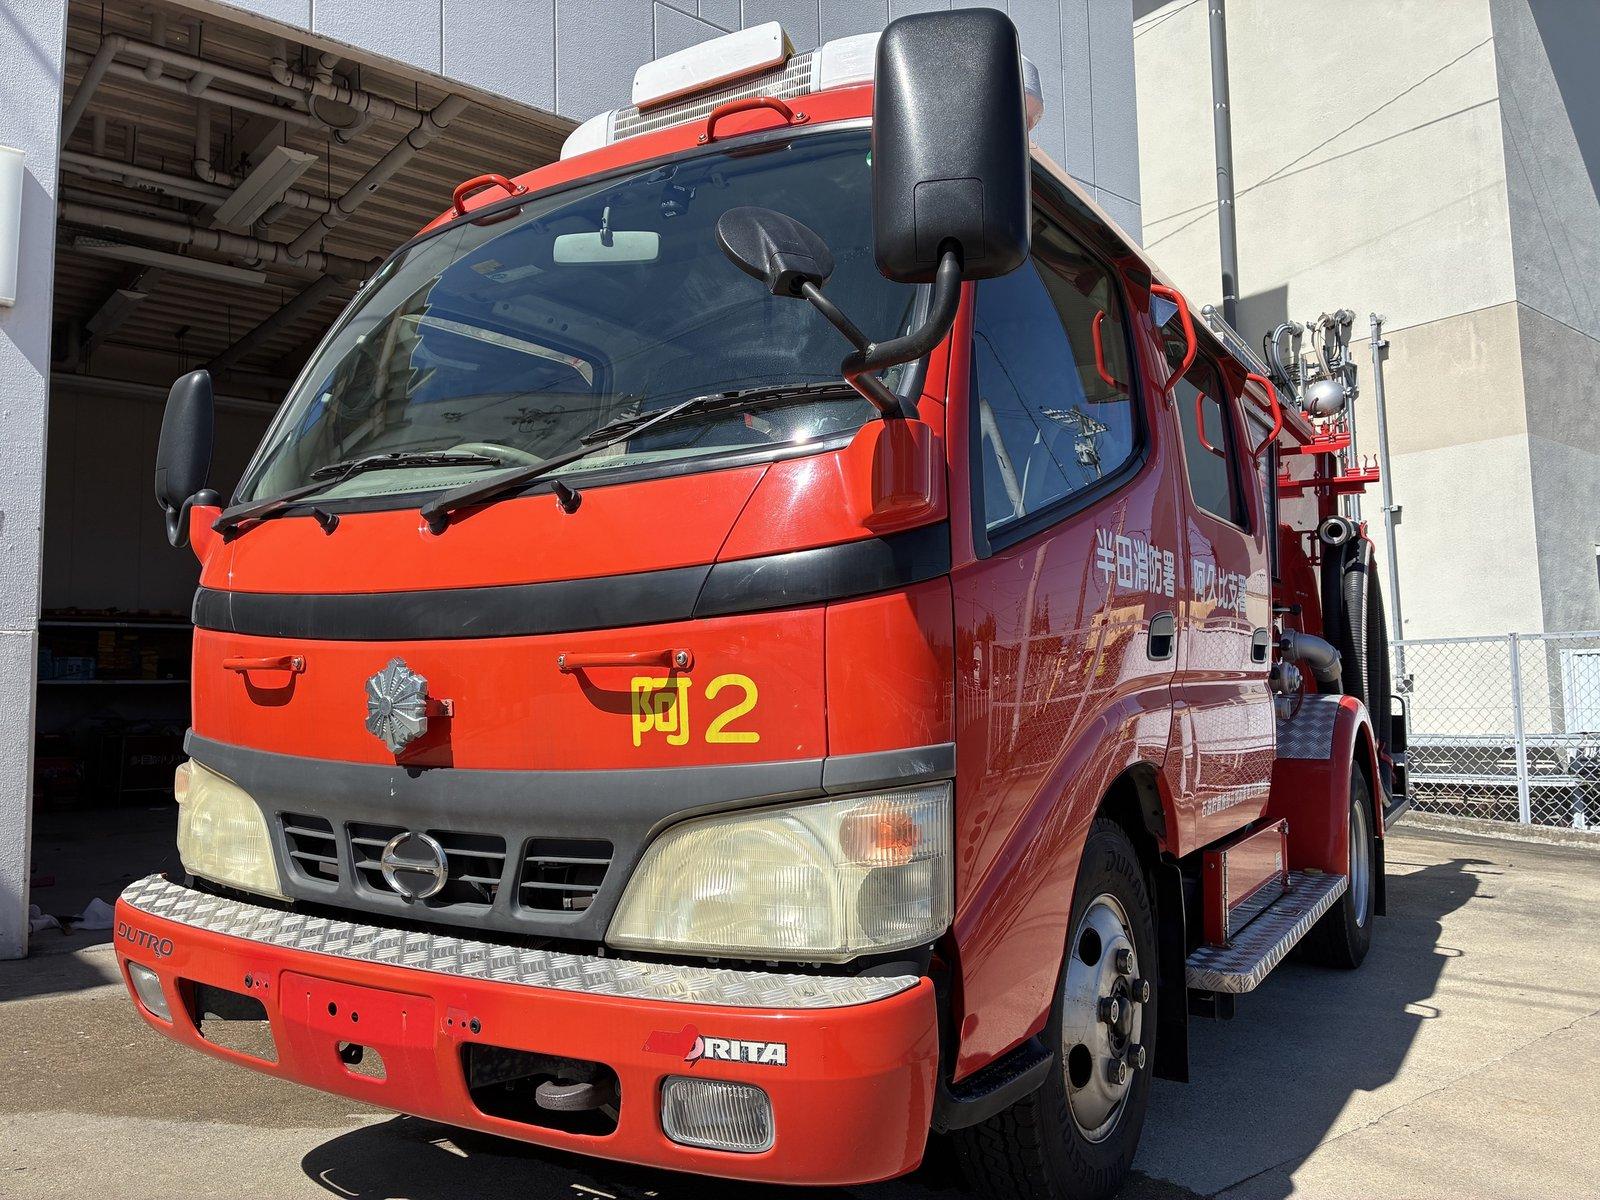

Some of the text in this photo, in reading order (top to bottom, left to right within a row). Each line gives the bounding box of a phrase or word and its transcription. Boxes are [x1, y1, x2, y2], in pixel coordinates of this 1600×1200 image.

[1096, 528, 1247, 613] 半田消防署 阿久比支署
[118, 921, 175, 958] DUTRO
